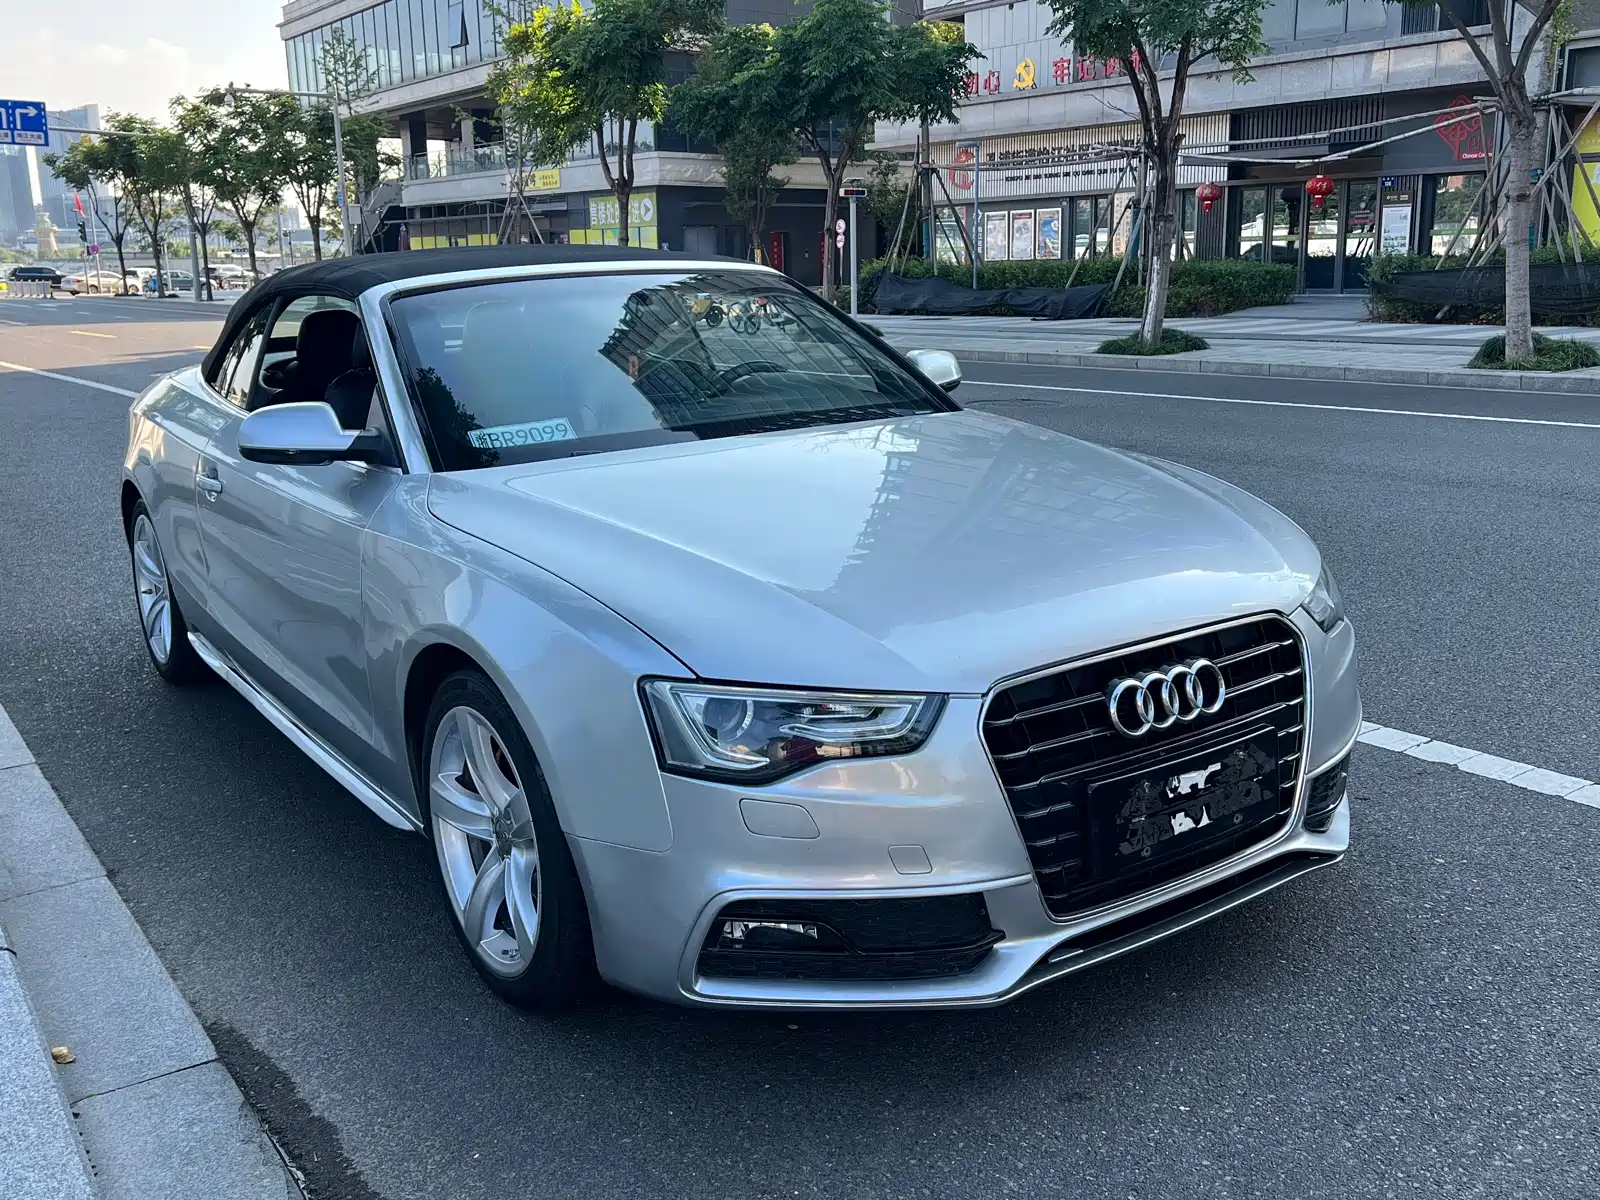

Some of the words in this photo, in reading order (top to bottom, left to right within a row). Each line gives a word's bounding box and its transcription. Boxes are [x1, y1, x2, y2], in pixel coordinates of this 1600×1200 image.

[591, 199, 640, 226] 售楼处由进
